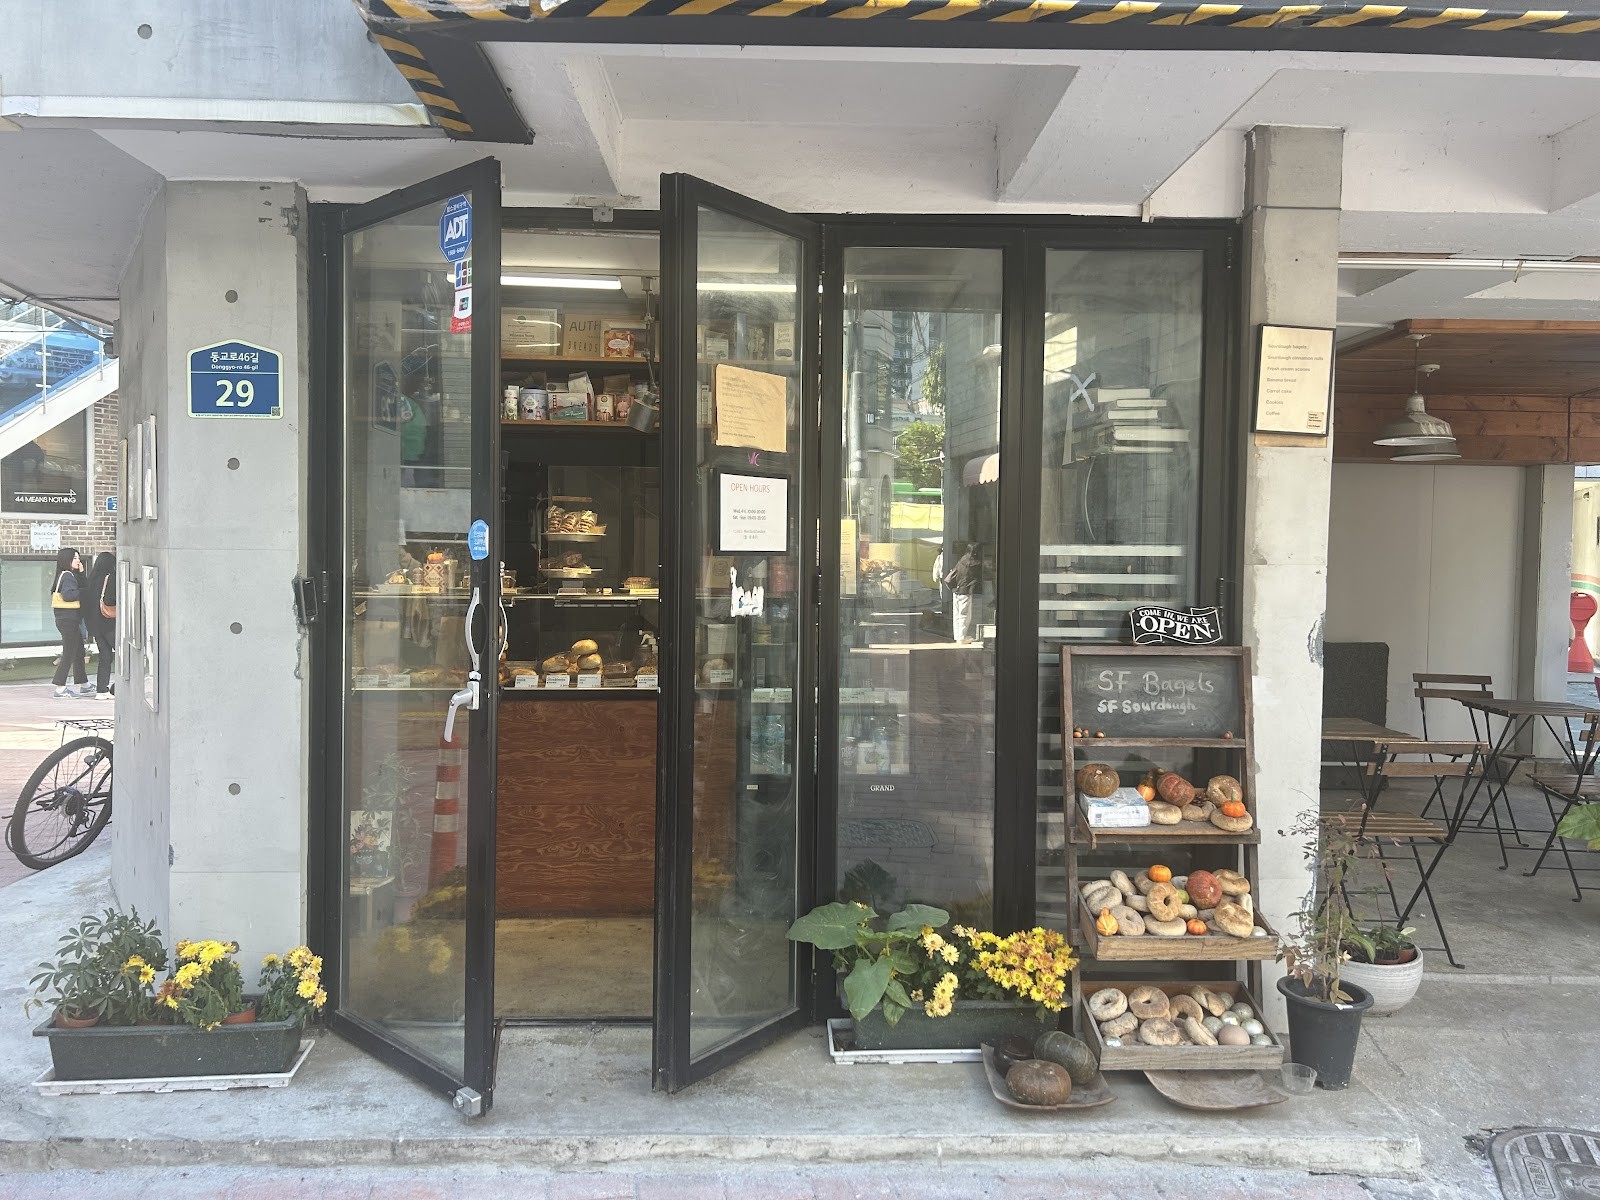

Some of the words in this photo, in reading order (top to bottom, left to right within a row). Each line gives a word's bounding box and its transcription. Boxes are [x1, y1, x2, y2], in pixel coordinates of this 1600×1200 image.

[445, 214, 468, 242] ADT
[456, 267, 472, 280] JCB
[210, 352, 259, 363] 동교로46길
[215, 379, 255, 408] 29
[730, 482, 748, 492] OPEN
[749, 483, 771, 494] HOURS
[48, 496, 77, 504] NOTHING
[1139, 609, 1161, 617] COME
[1176, 614, 1189, 623] WE
[1191, 616, 1209, 624] ARE
[1139, 615, 1212, 640] OPEN
[1097, 670, 1132, 694] SF
[1142, 670, 1215, 698] Bagels
[1097, 700, 1118, 714] SF
[1122, 696, 1198, 715] Sourdough
[870, 784, 895, 792] GRAND
